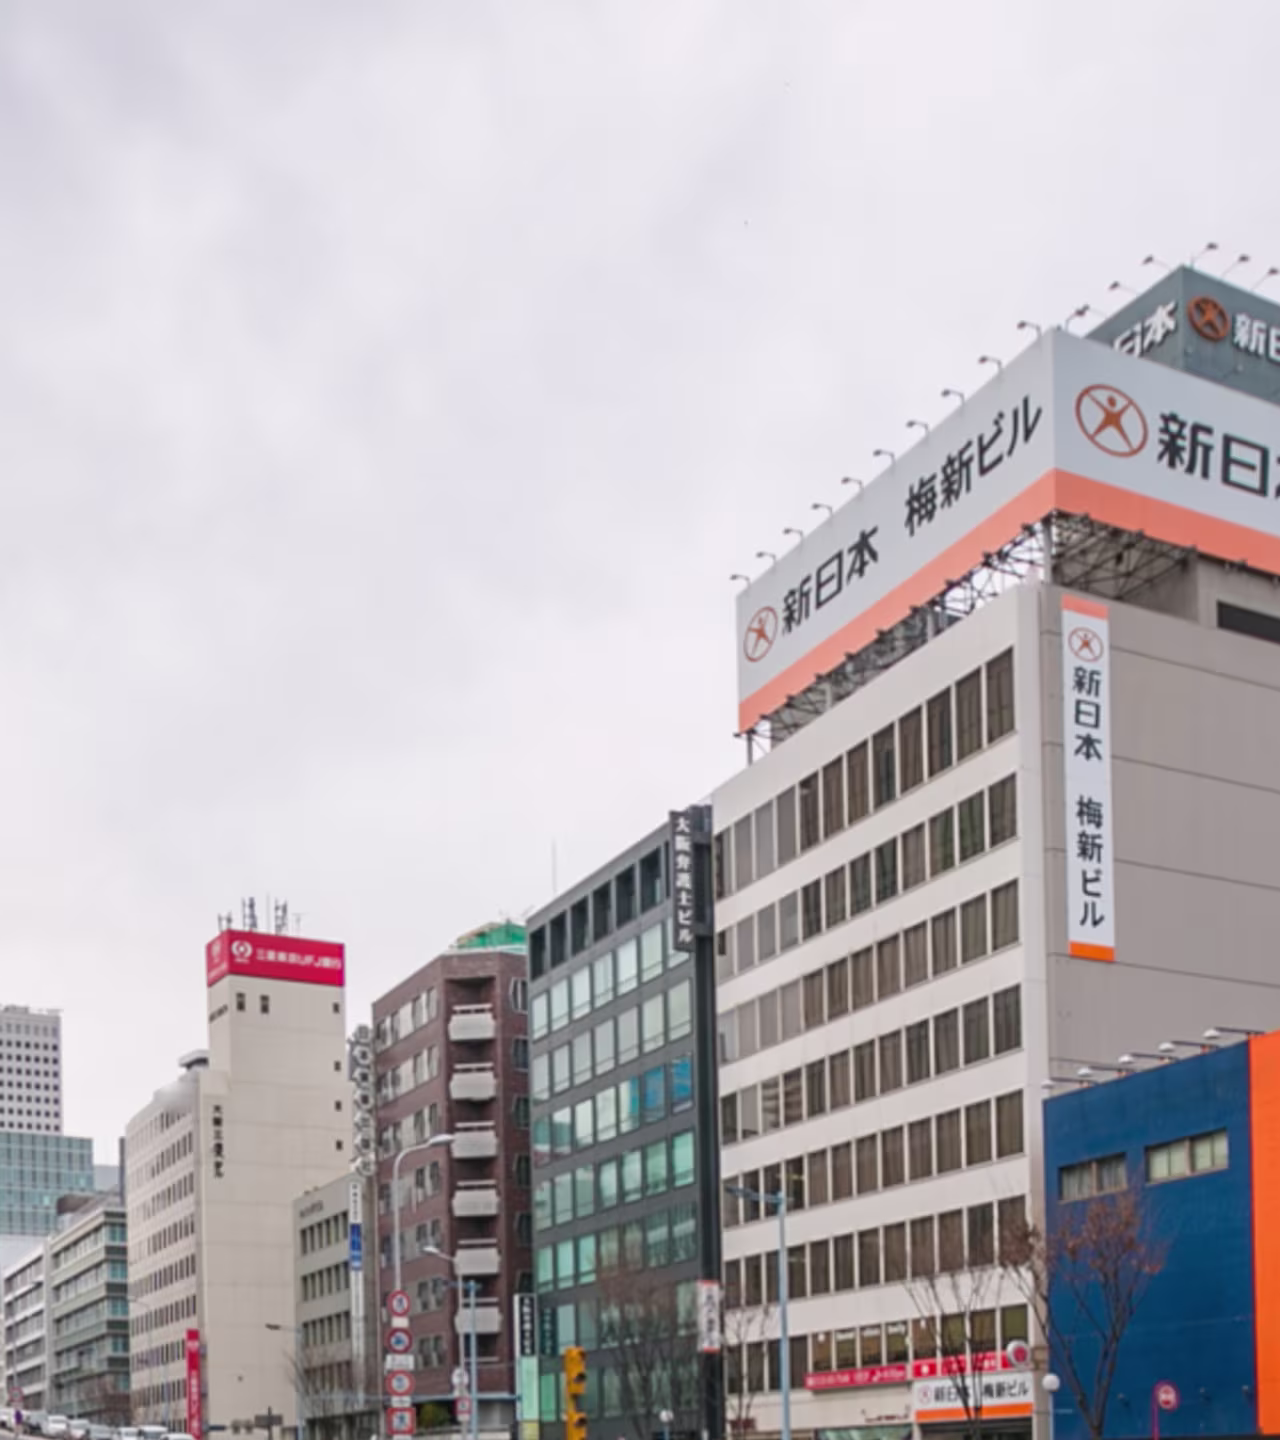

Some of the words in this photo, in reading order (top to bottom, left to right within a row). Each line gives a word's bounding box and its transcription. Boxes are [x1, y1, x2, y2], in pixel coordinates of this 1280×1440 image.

[782, 526, 880, 636] 新日本
[904, 394, 1043, 537] 梅新ビル
[1072, 665, 1103, 762] 新日本
[1076, 794, 1105, 928] 梅新ビル
